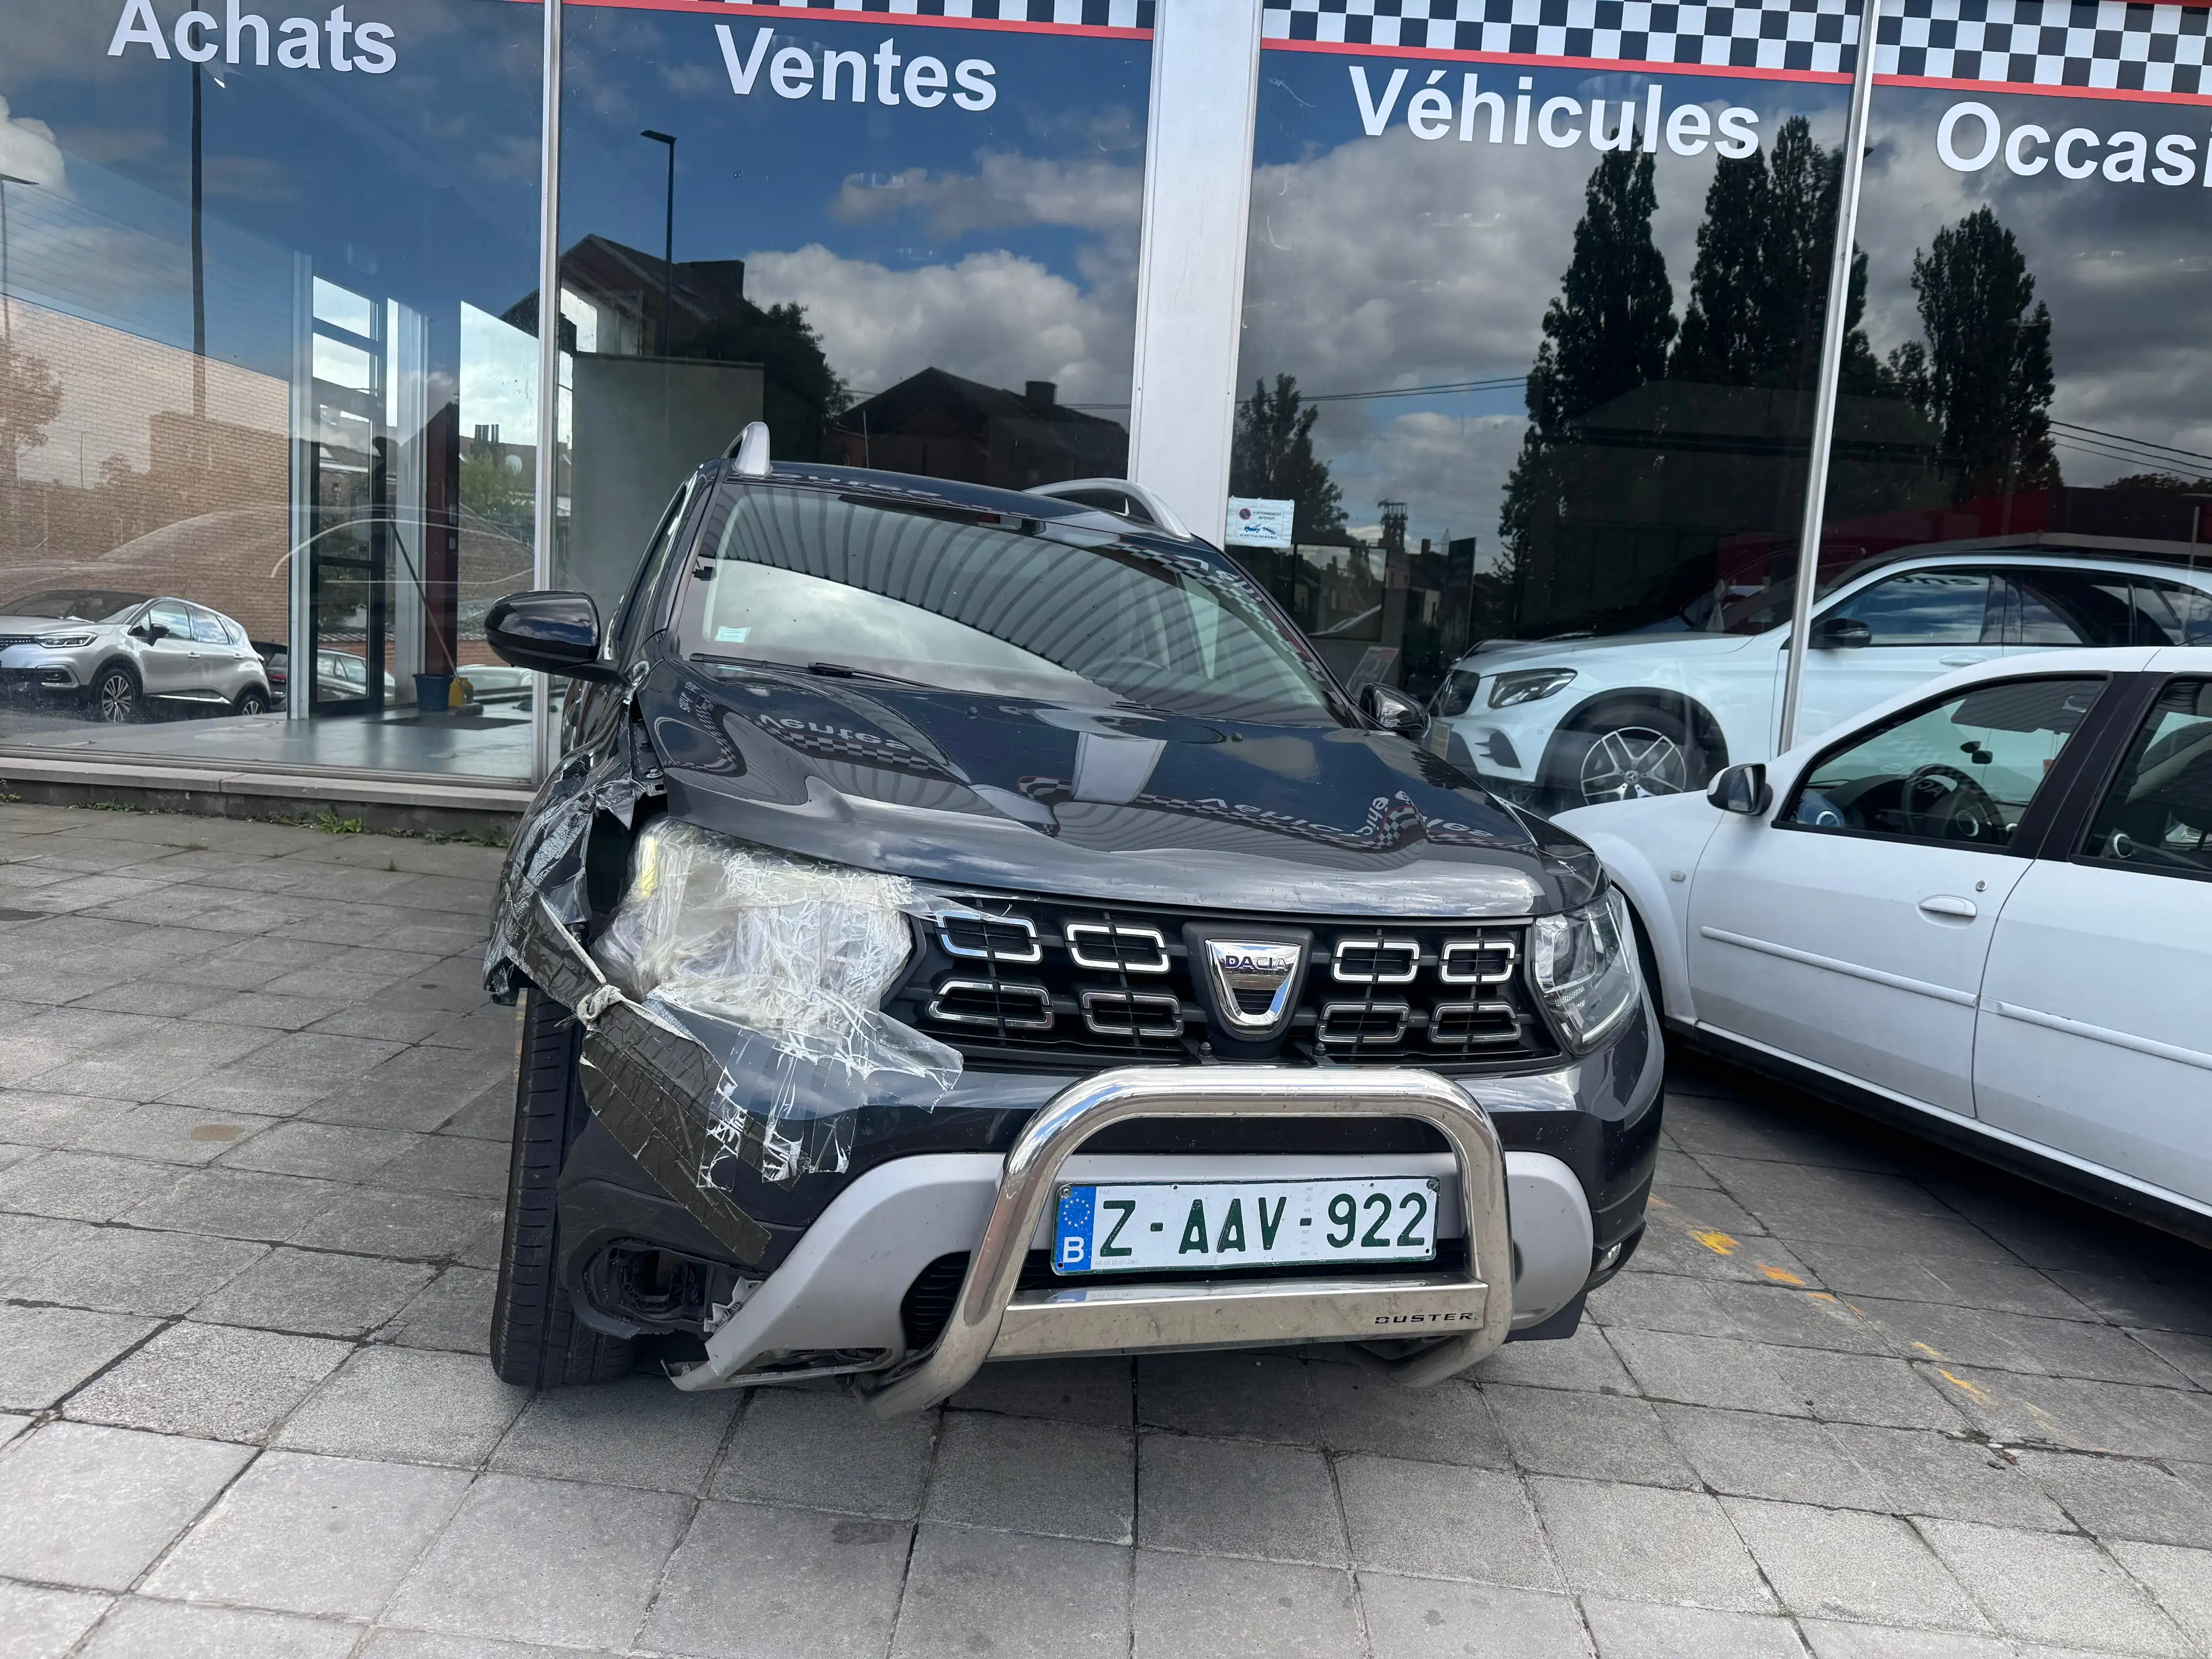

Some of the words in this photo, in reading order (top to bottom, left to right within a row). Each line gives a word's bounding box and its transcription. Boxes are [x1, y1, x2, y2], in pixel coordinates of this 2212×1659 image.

[107, 0, 397, 74] Achats
[714, 24, 997, 111] Ventes
[1349, 66, 1759, 159] Véhicules
[1225, 955, 1288, 971] DACIA
[1100, 1192, 1427, 1257] Z-AAV-922
[1063, 1236, 1084, 1263] B
[1375, 1312, 1473, 1324] DUSTER
